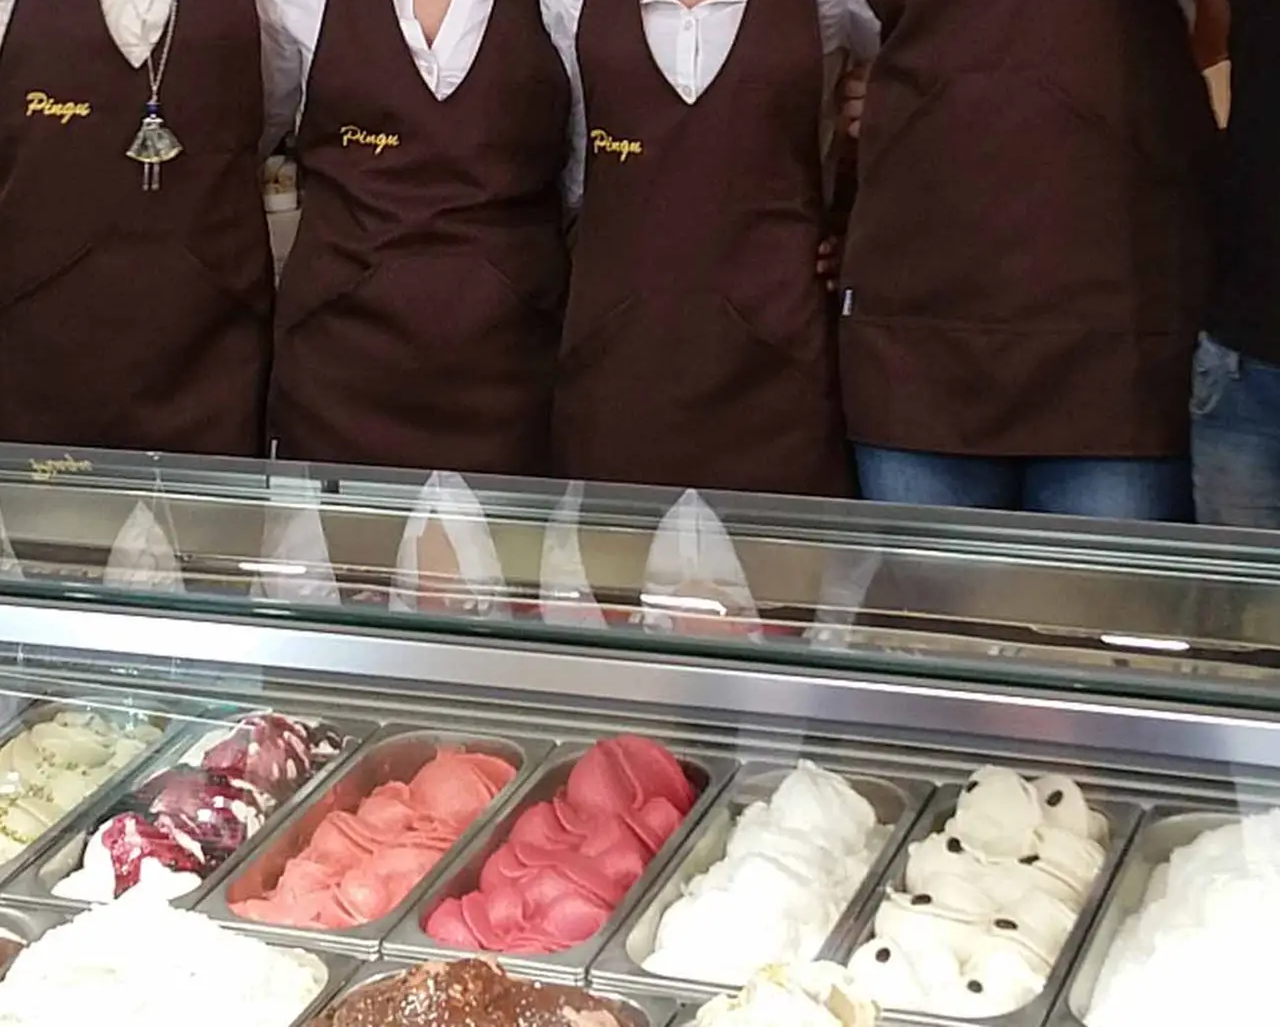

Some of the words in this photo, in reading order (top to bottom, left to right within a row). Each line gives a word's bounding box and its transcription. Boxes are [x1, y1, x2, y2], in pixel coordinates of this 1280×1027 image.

[25, 90, 90, 124] Pingu
[340, 124, 400, 153] Pingu
[590, 127, 643, 161] Pingu
